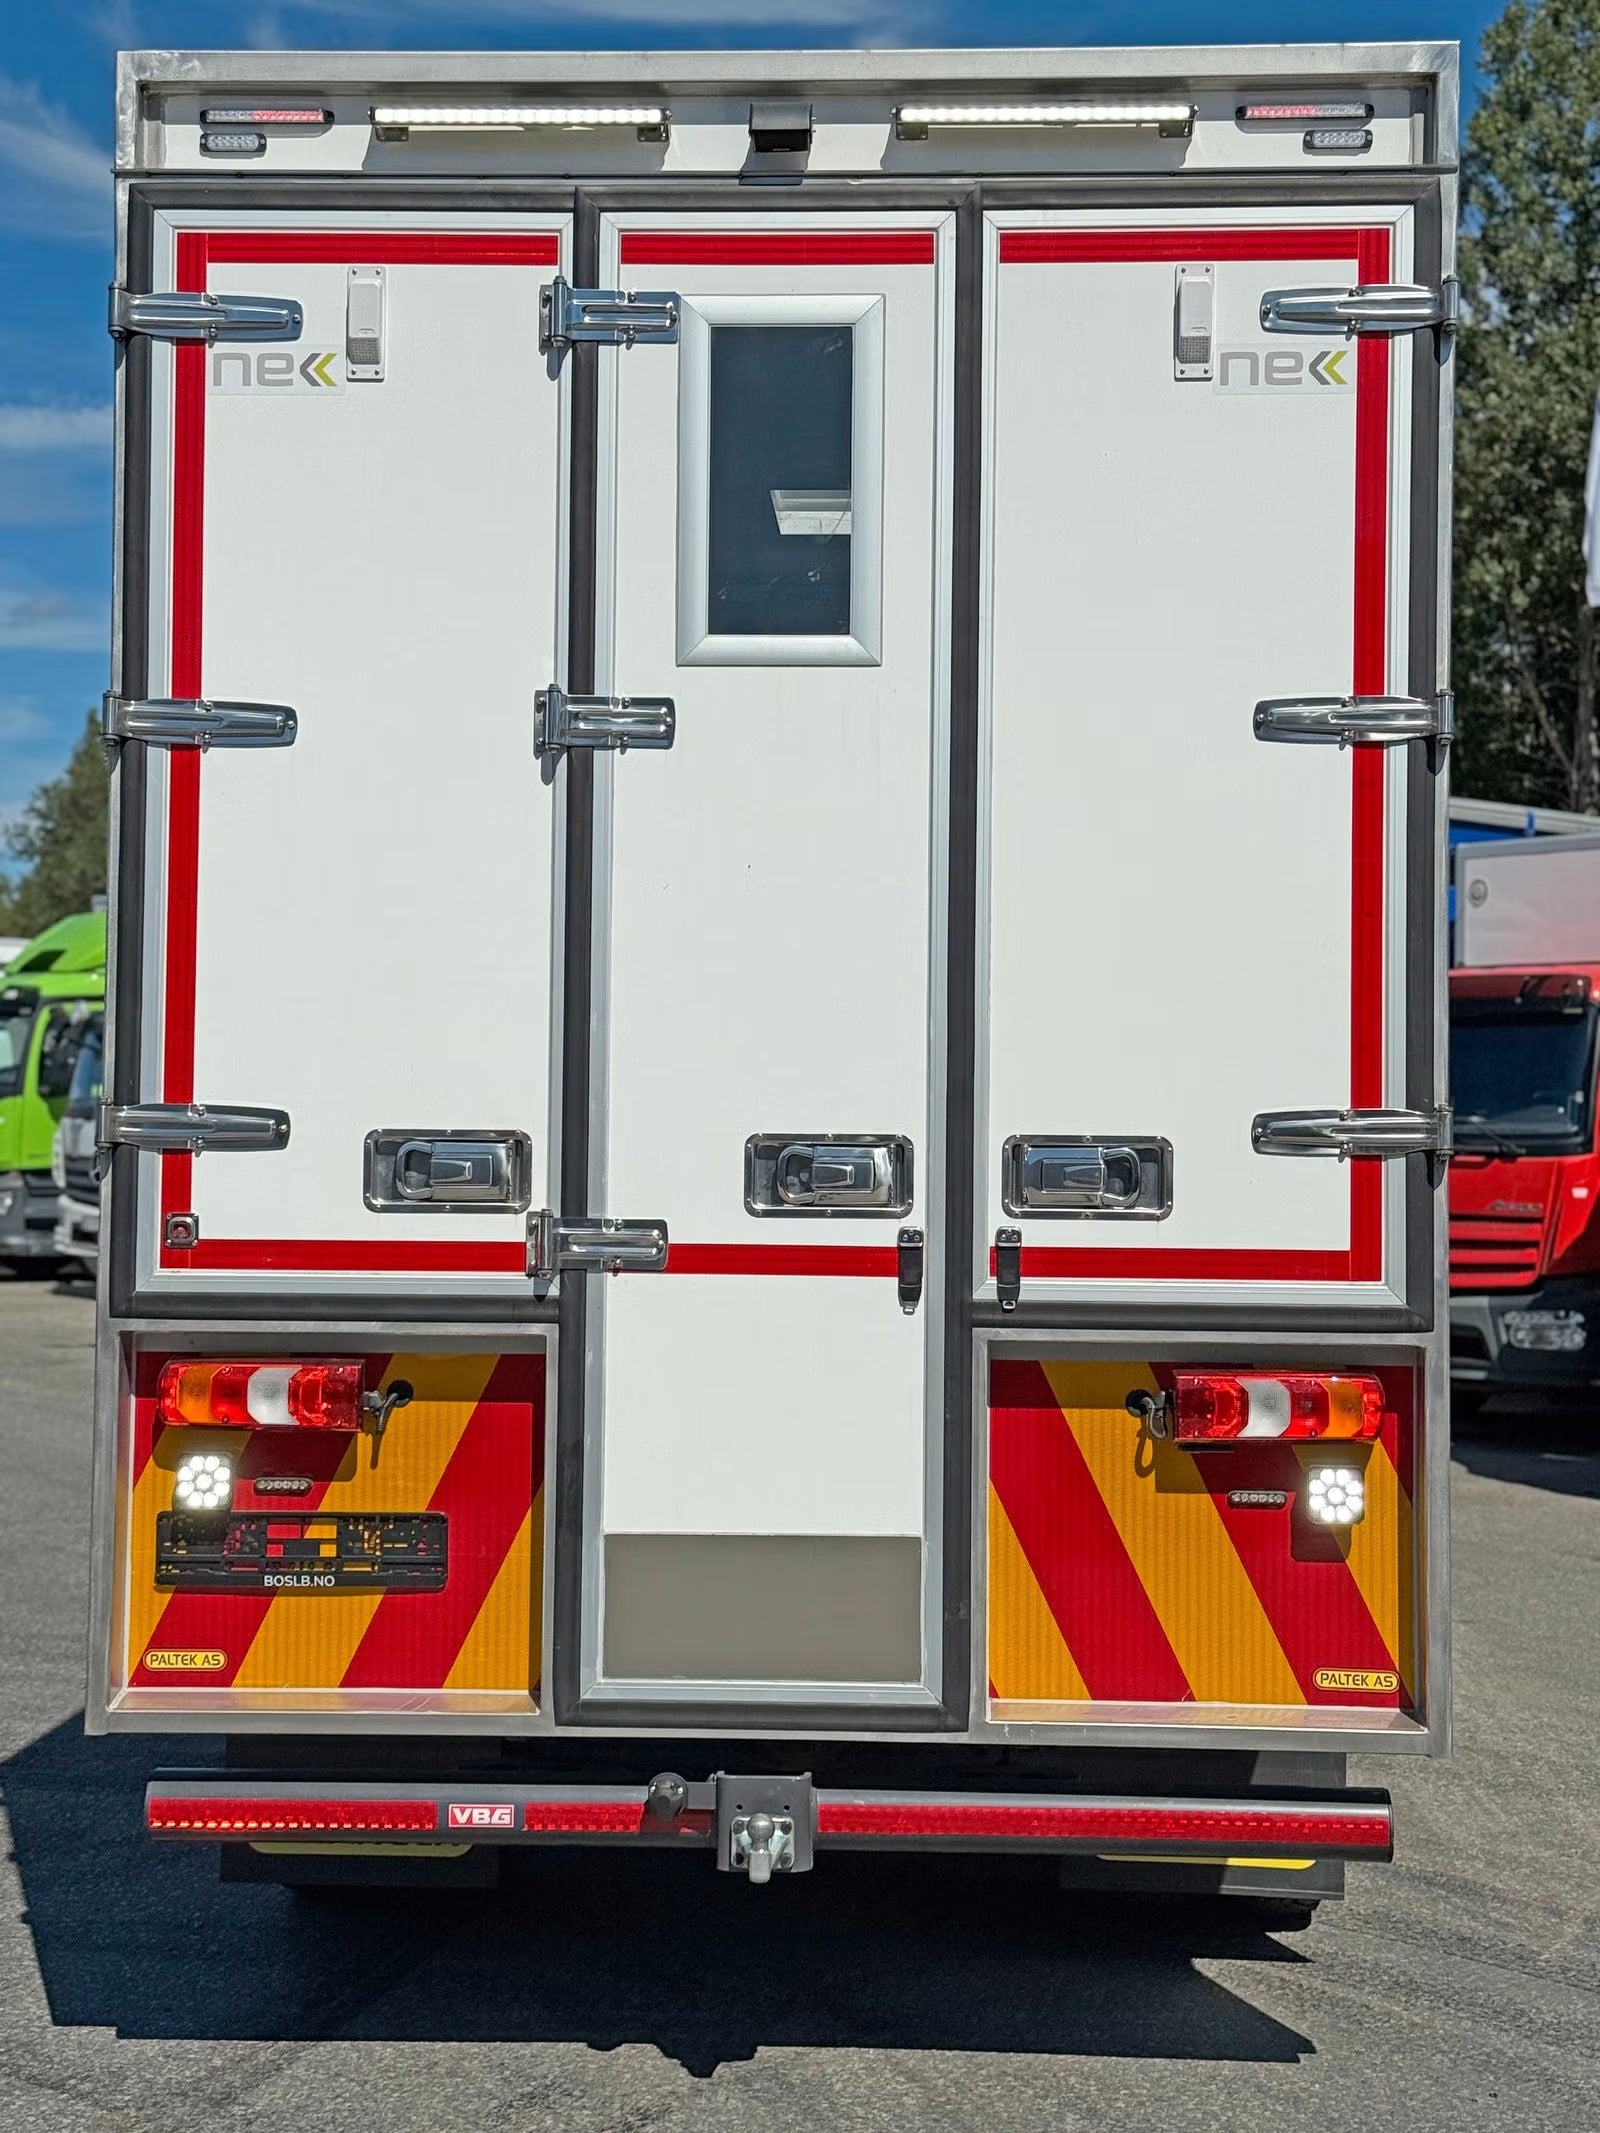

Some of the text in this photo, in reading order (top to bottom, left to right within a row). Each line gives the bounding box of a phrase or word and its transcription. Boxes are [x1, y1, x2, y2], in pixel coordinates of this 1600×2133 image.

[264, 1575, 335, 1587] BOSLB.NO
[150, 1654, 221, 1666] PALTEK AS
[1320, 1673, 1393, 1688] PALTEK AS
[452, 1807, 511, 1824] VBG
